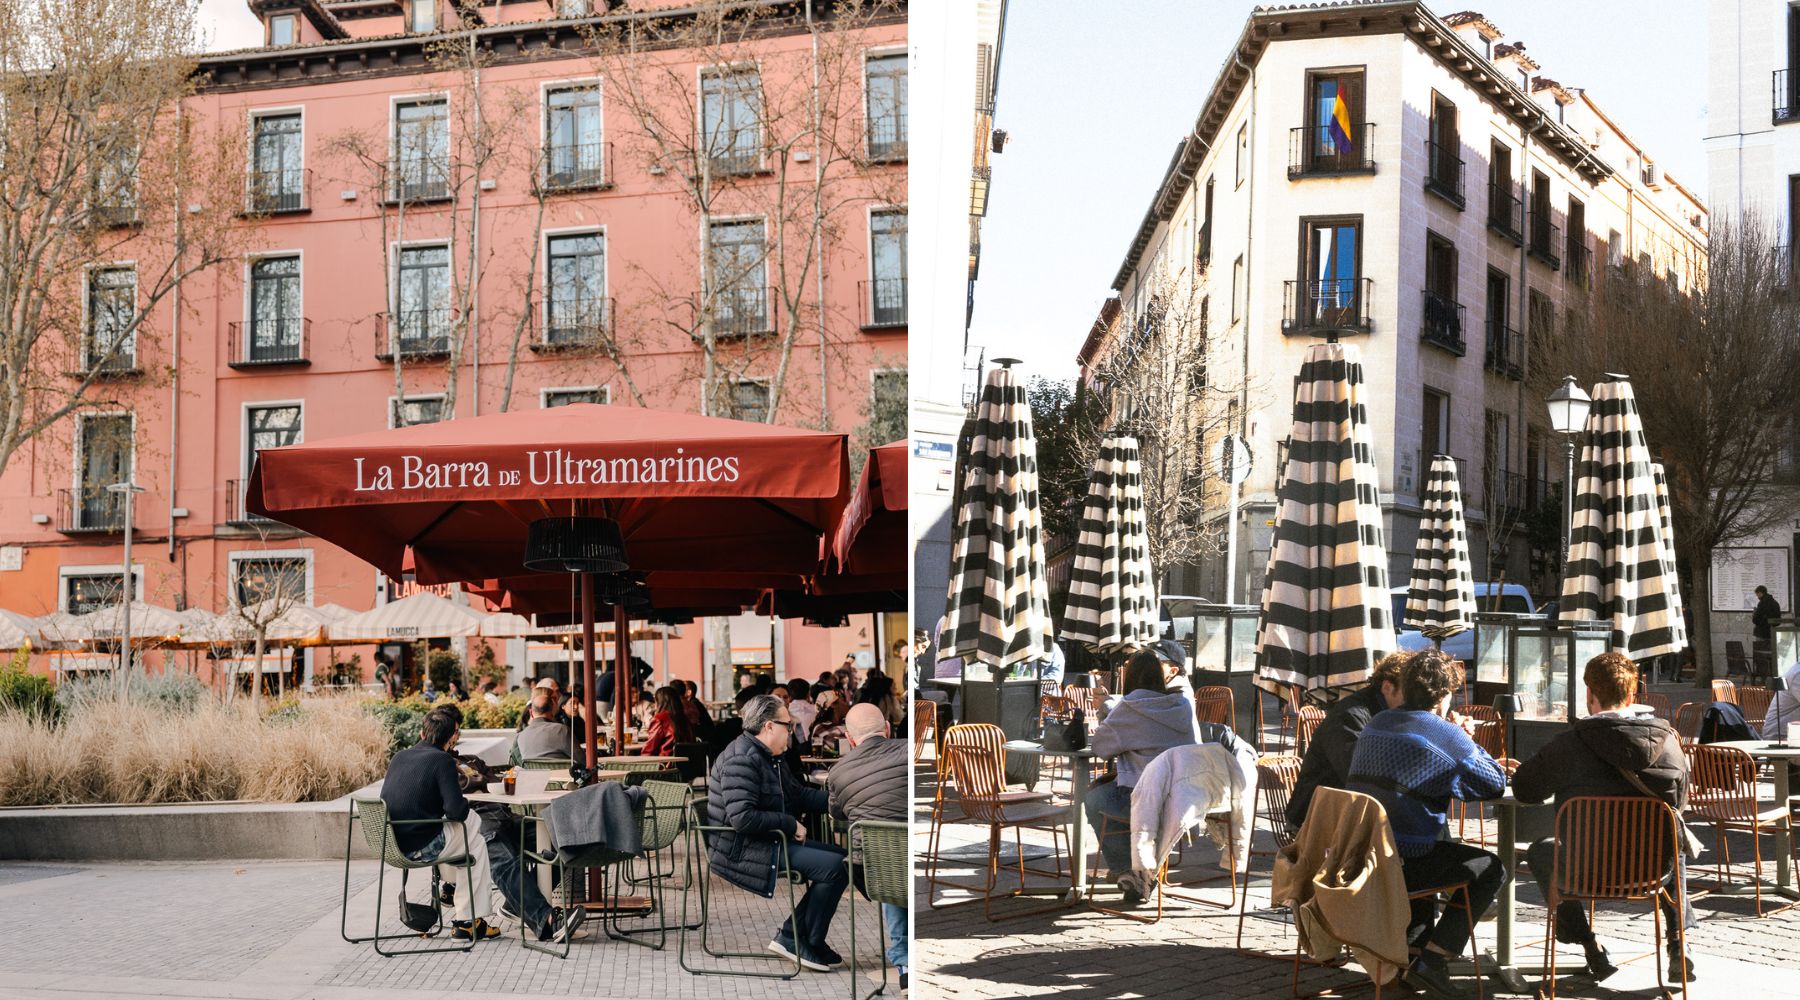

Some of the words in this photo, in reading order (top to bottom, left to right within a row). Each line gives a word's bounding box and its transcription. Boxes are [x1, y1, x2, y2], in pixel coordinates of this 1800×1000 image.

[353, 457, 395, 492] La
[400, 455, 492, 490] Barra
[498, 469, 521, 487] DE
[526, 447, 740, 486] Ultramarines
[386, 626, 420, 638] LAMUCCA
